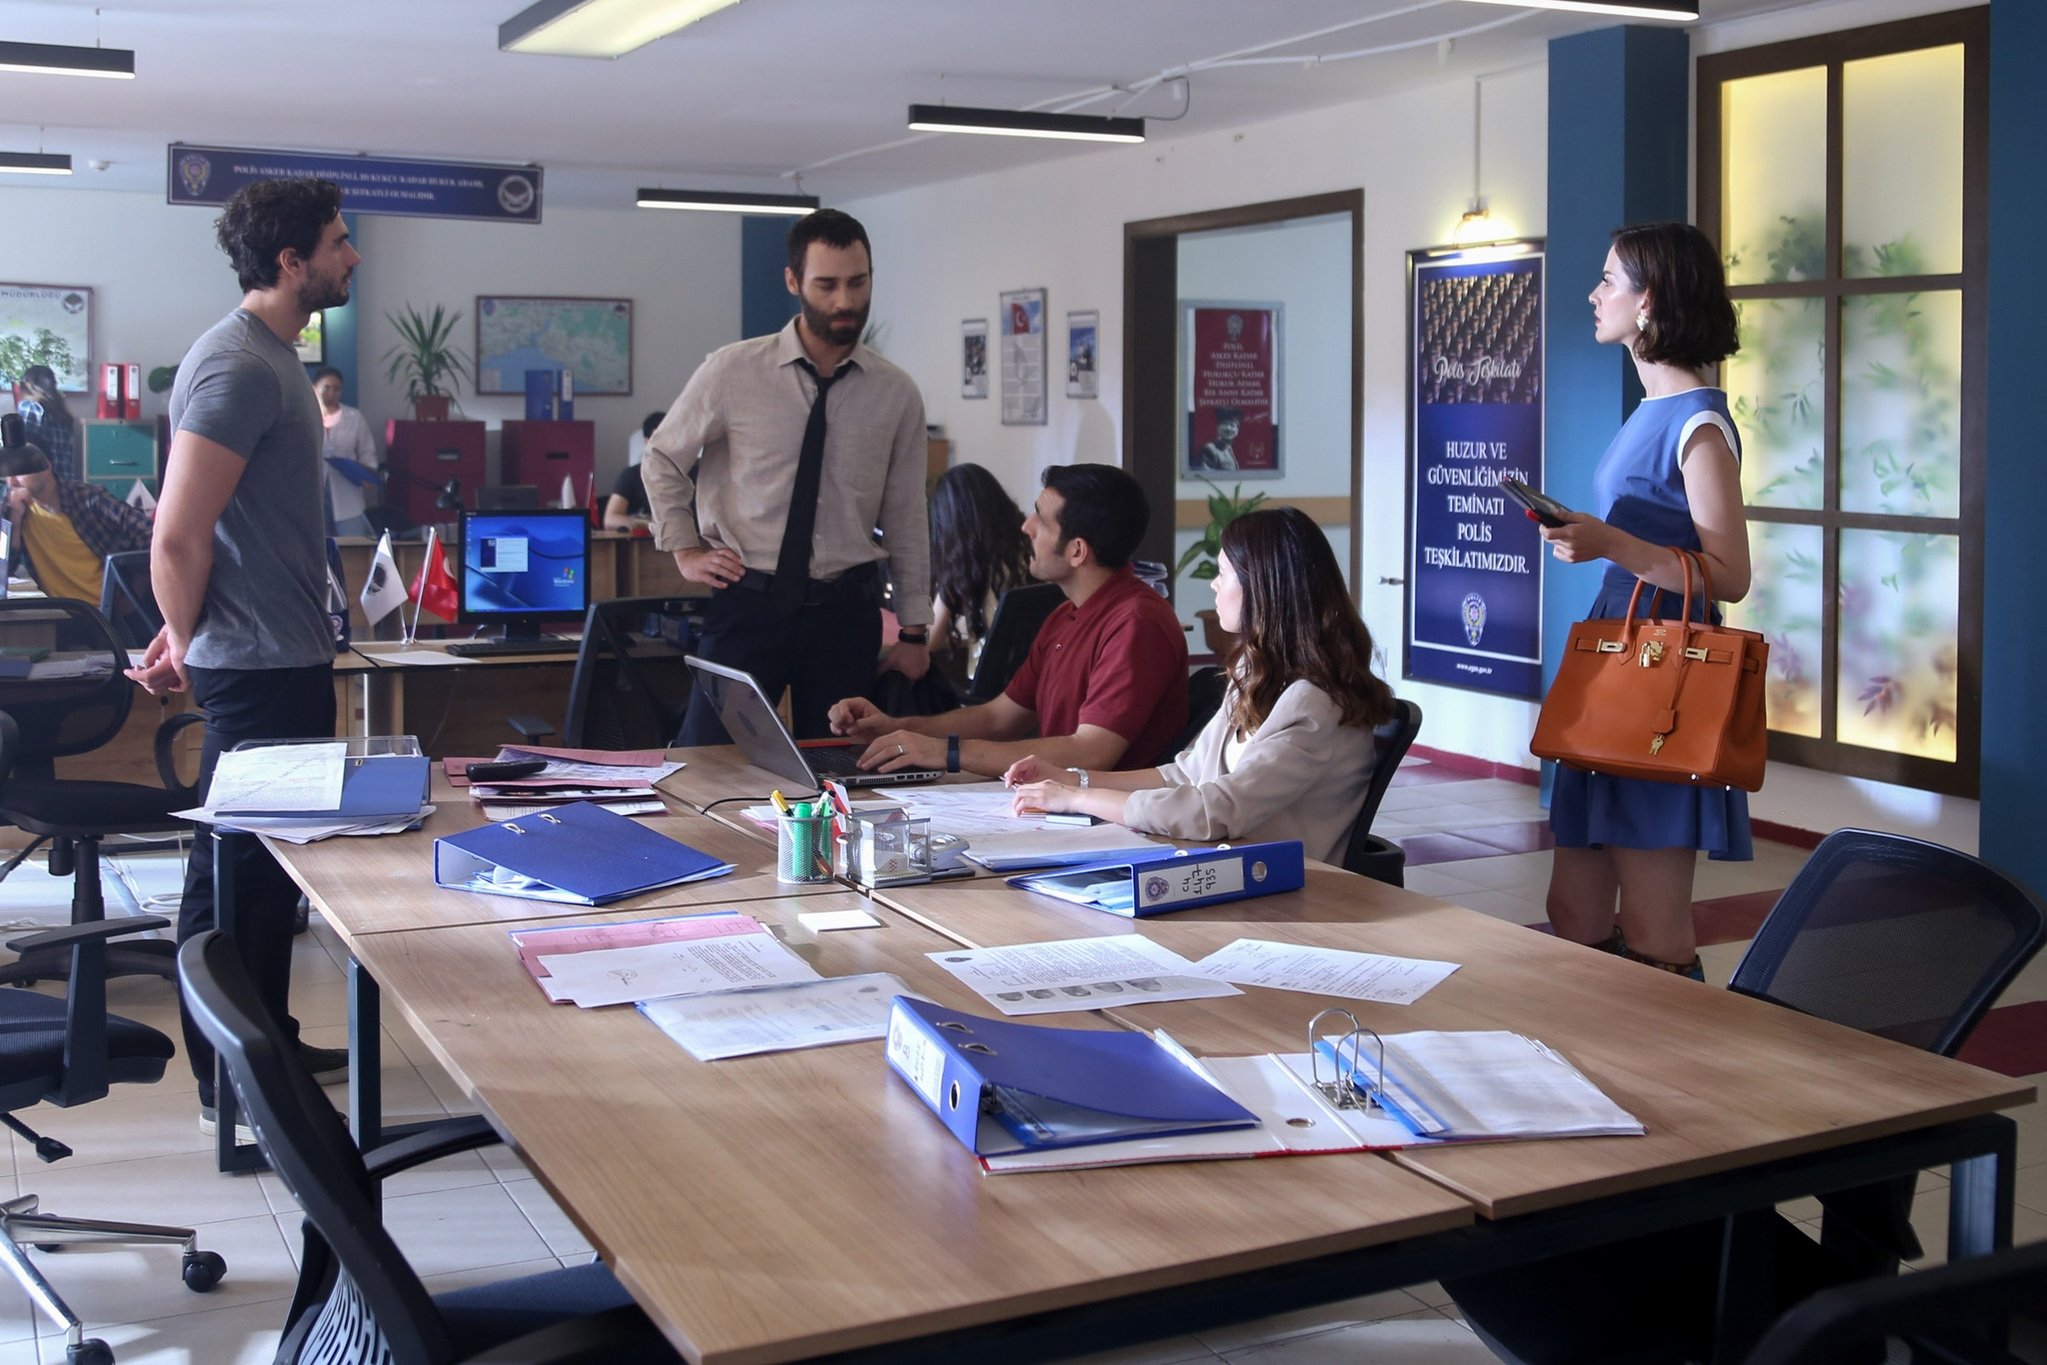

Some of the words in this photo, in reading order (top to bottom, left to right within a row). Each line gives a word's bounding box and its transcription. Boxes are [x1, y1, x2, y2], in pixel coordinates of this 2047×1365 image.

[1446, 441, 1487, 459] HUZUR
[1490, 442, 1507, 460] VE
[1447, 492, 1505, 516] TEMİNATI
[1458, 521, 1493, 543] POLİS
[1424, 546, 1530, 574] TEŞKİLATIMIZDIR.
[1192, 863, 1203, 895] 147
